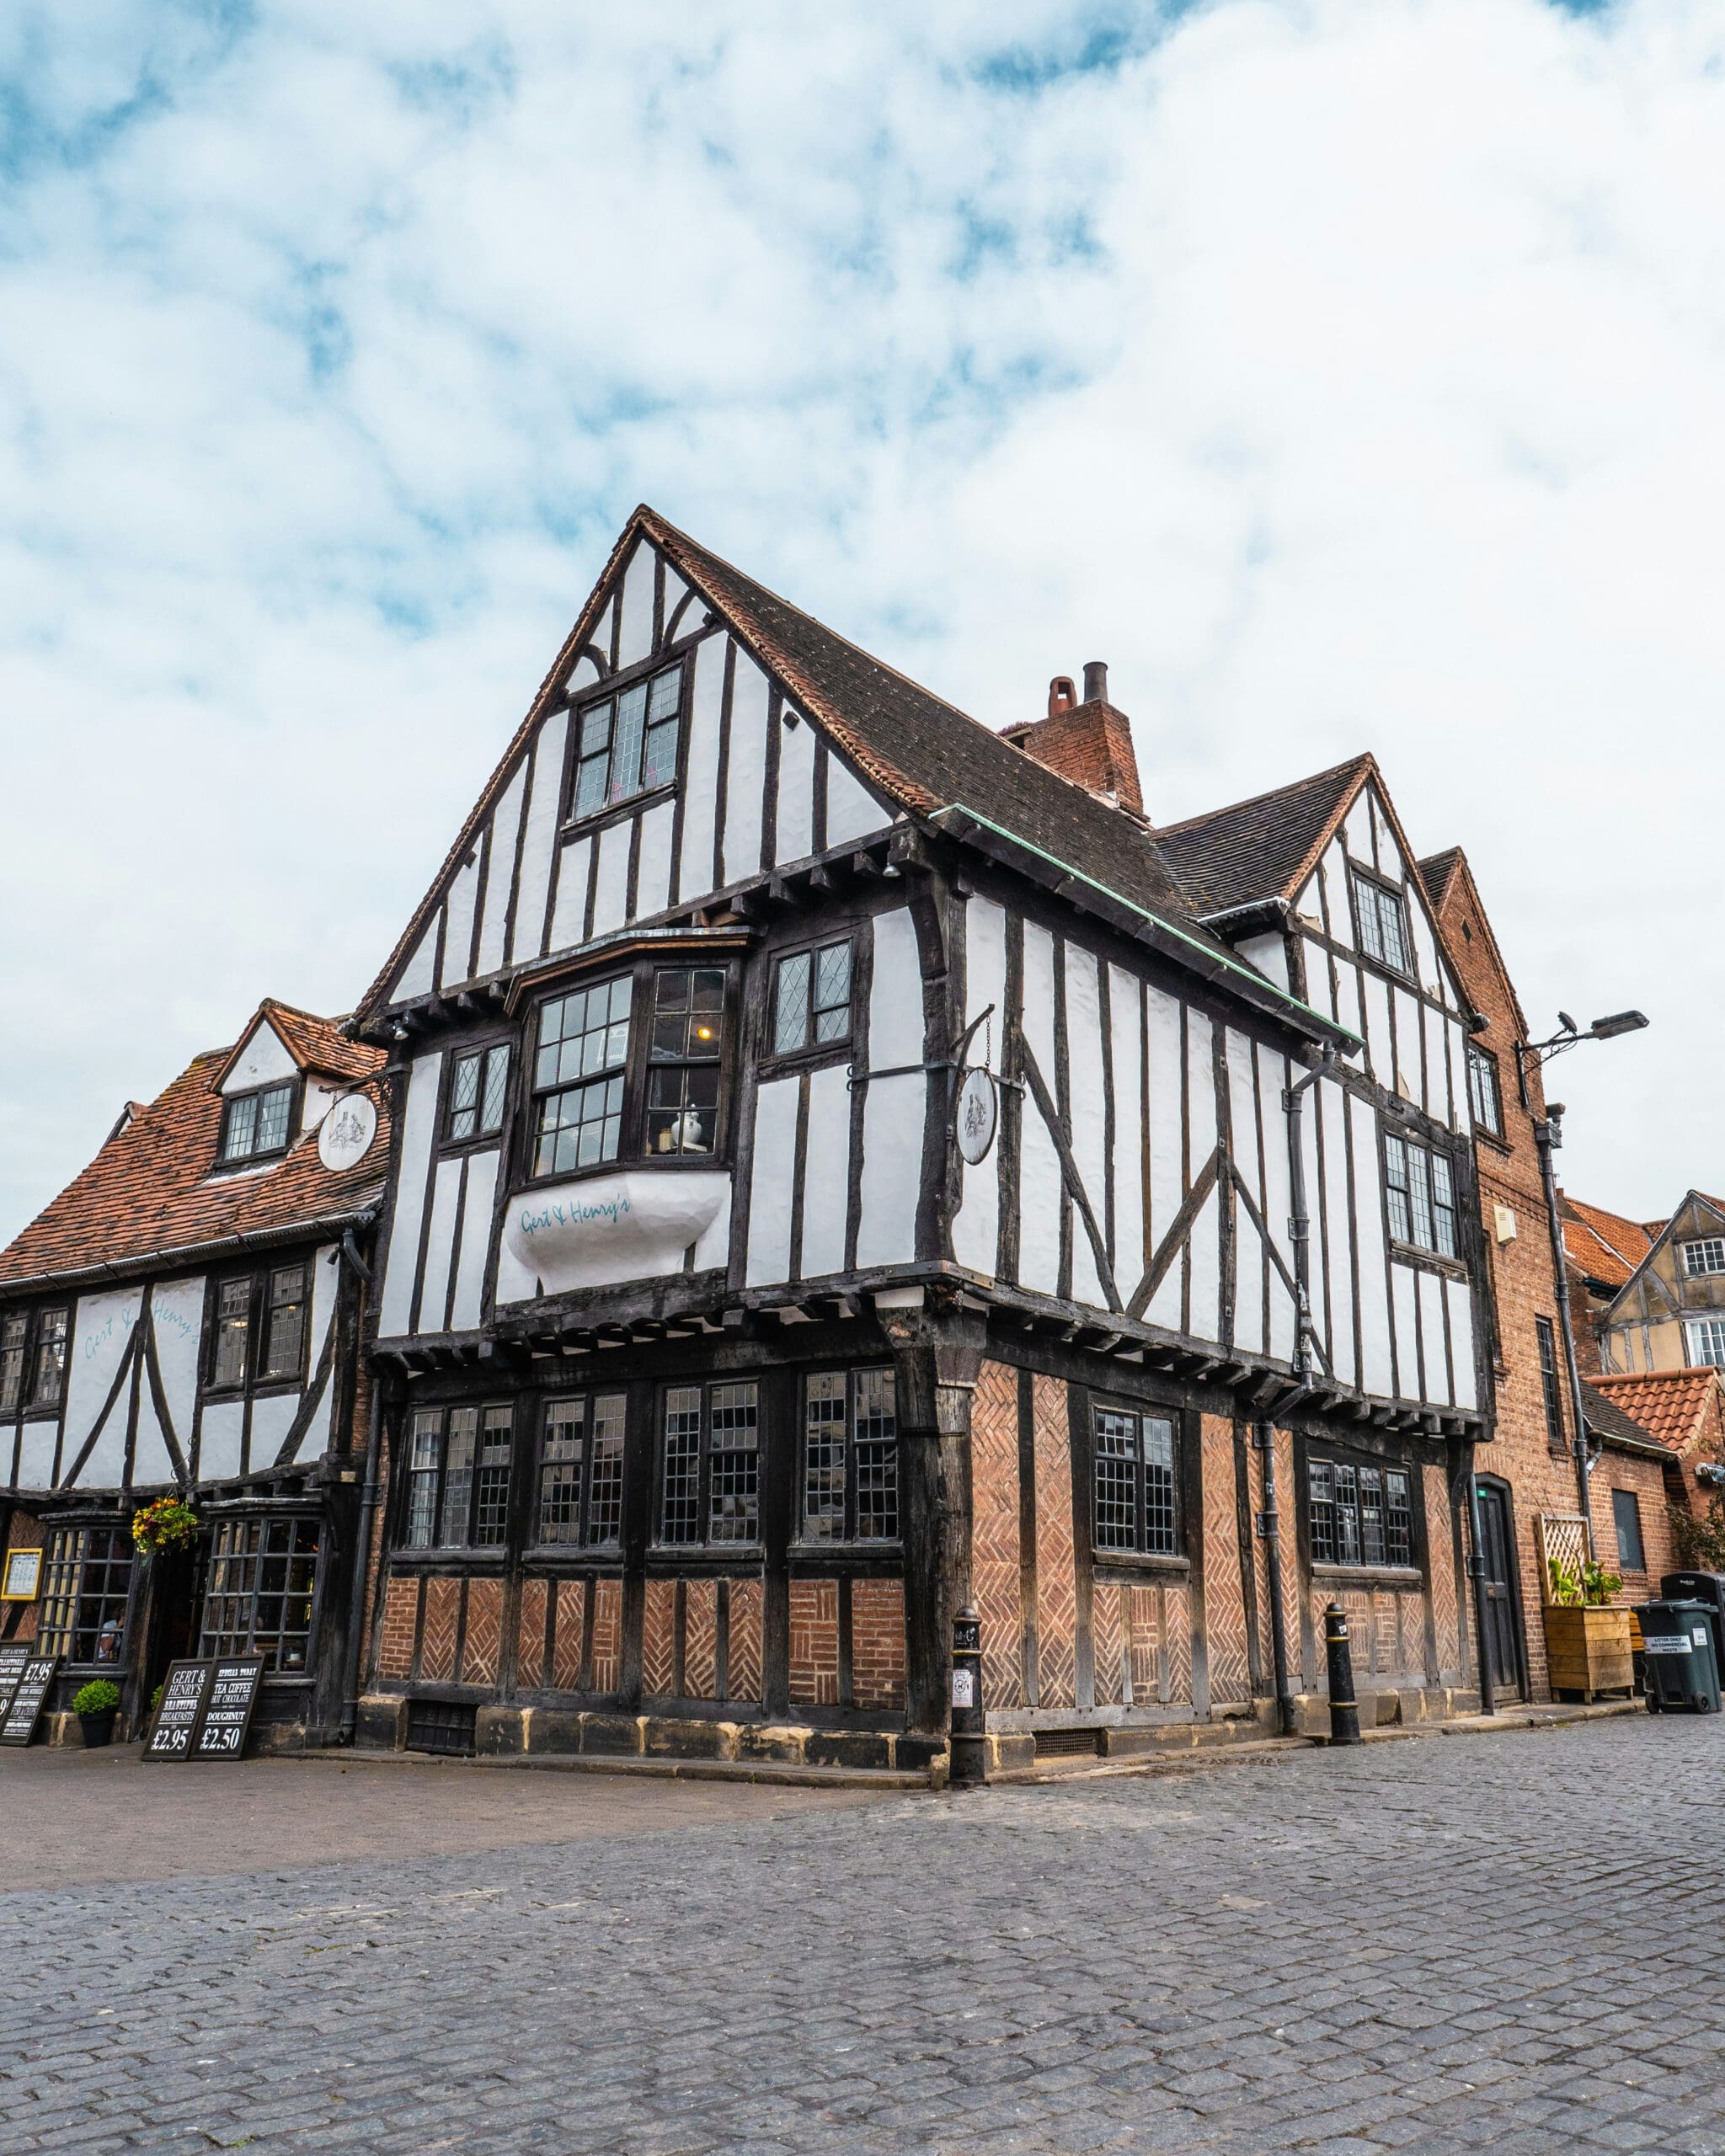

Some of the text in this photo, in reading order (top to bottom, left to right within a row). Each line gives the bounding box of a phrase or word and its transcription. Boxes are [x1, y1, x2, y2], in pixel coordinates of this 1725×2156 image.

[521, 1193, 631, 1235] Gert & Henry's
[85, 1299, 200, 1359] Gert & Henry's
[23, 1663, 52, 1682] £7.95
[173, 1669, 206, 1684] GERT &
[168, 1684, 203, 1696] HENRY'S
[214, 1683, 253, 1694] TEA COFFEE
[211, 1694, 250, 1704] HOT CHOCOLATE
[159, 1711, 195, 1721] BREAKFASTS
[206, 1712, 246, 1721] DOUGHNUT
[151, 1729, 189, 1750] £2.95
[200, 1728, 240, 1749] £2.50
